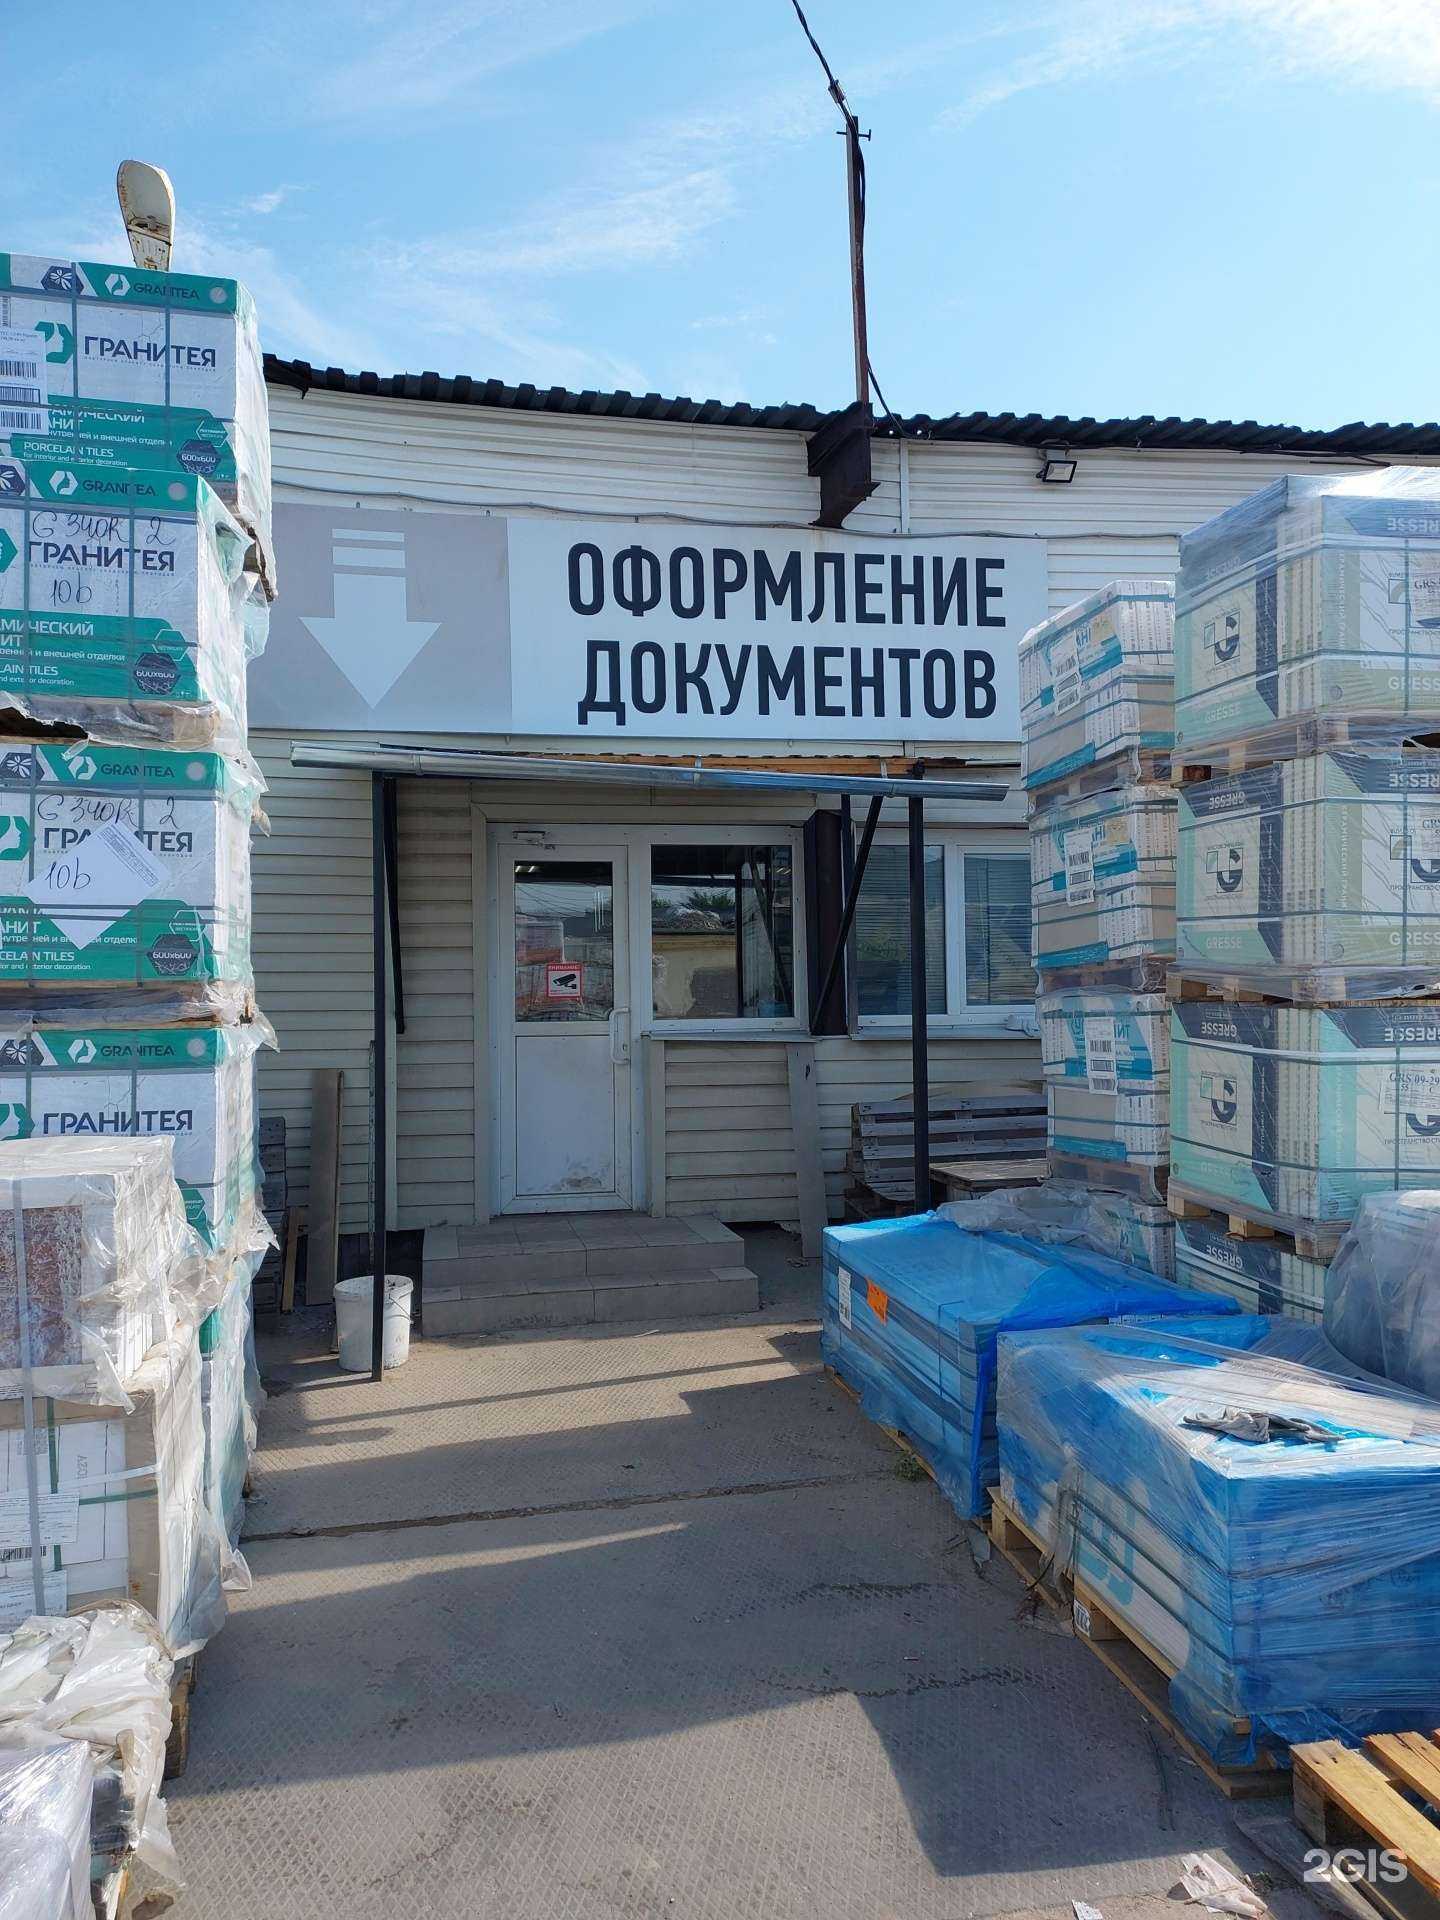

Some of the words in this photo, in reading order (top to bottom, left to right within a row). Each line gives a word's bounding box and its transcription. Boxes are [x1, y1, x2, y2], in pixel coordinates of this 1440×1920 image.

[84, 335, 217, 368] ГРАНИТЕЯ
[86, 447, 114, 458] TILES
[82, 479, 156, 497] GRANIEA
[567, 542, 1006, 628] ОФОРМЛЕНИЕ
[0, 618, 94, 636] МИЧЕСКИЙ
[577, 639, 998, 727] ДОКУМЕНТОВ
[44, 827, 193, 852] ГРАТЕЯ
[0, 950, 41, 961] CELAN
[42, 951, 75, 962] TILES
[1200, 1020, 1238, 1039] GRESSE
[1383, 1026, 1440, 1043] RESSE
[43, 1109, 193, 1135] ГРАНИТЕЯ
[1205, 1242, 1243, 1270] GRESSE
